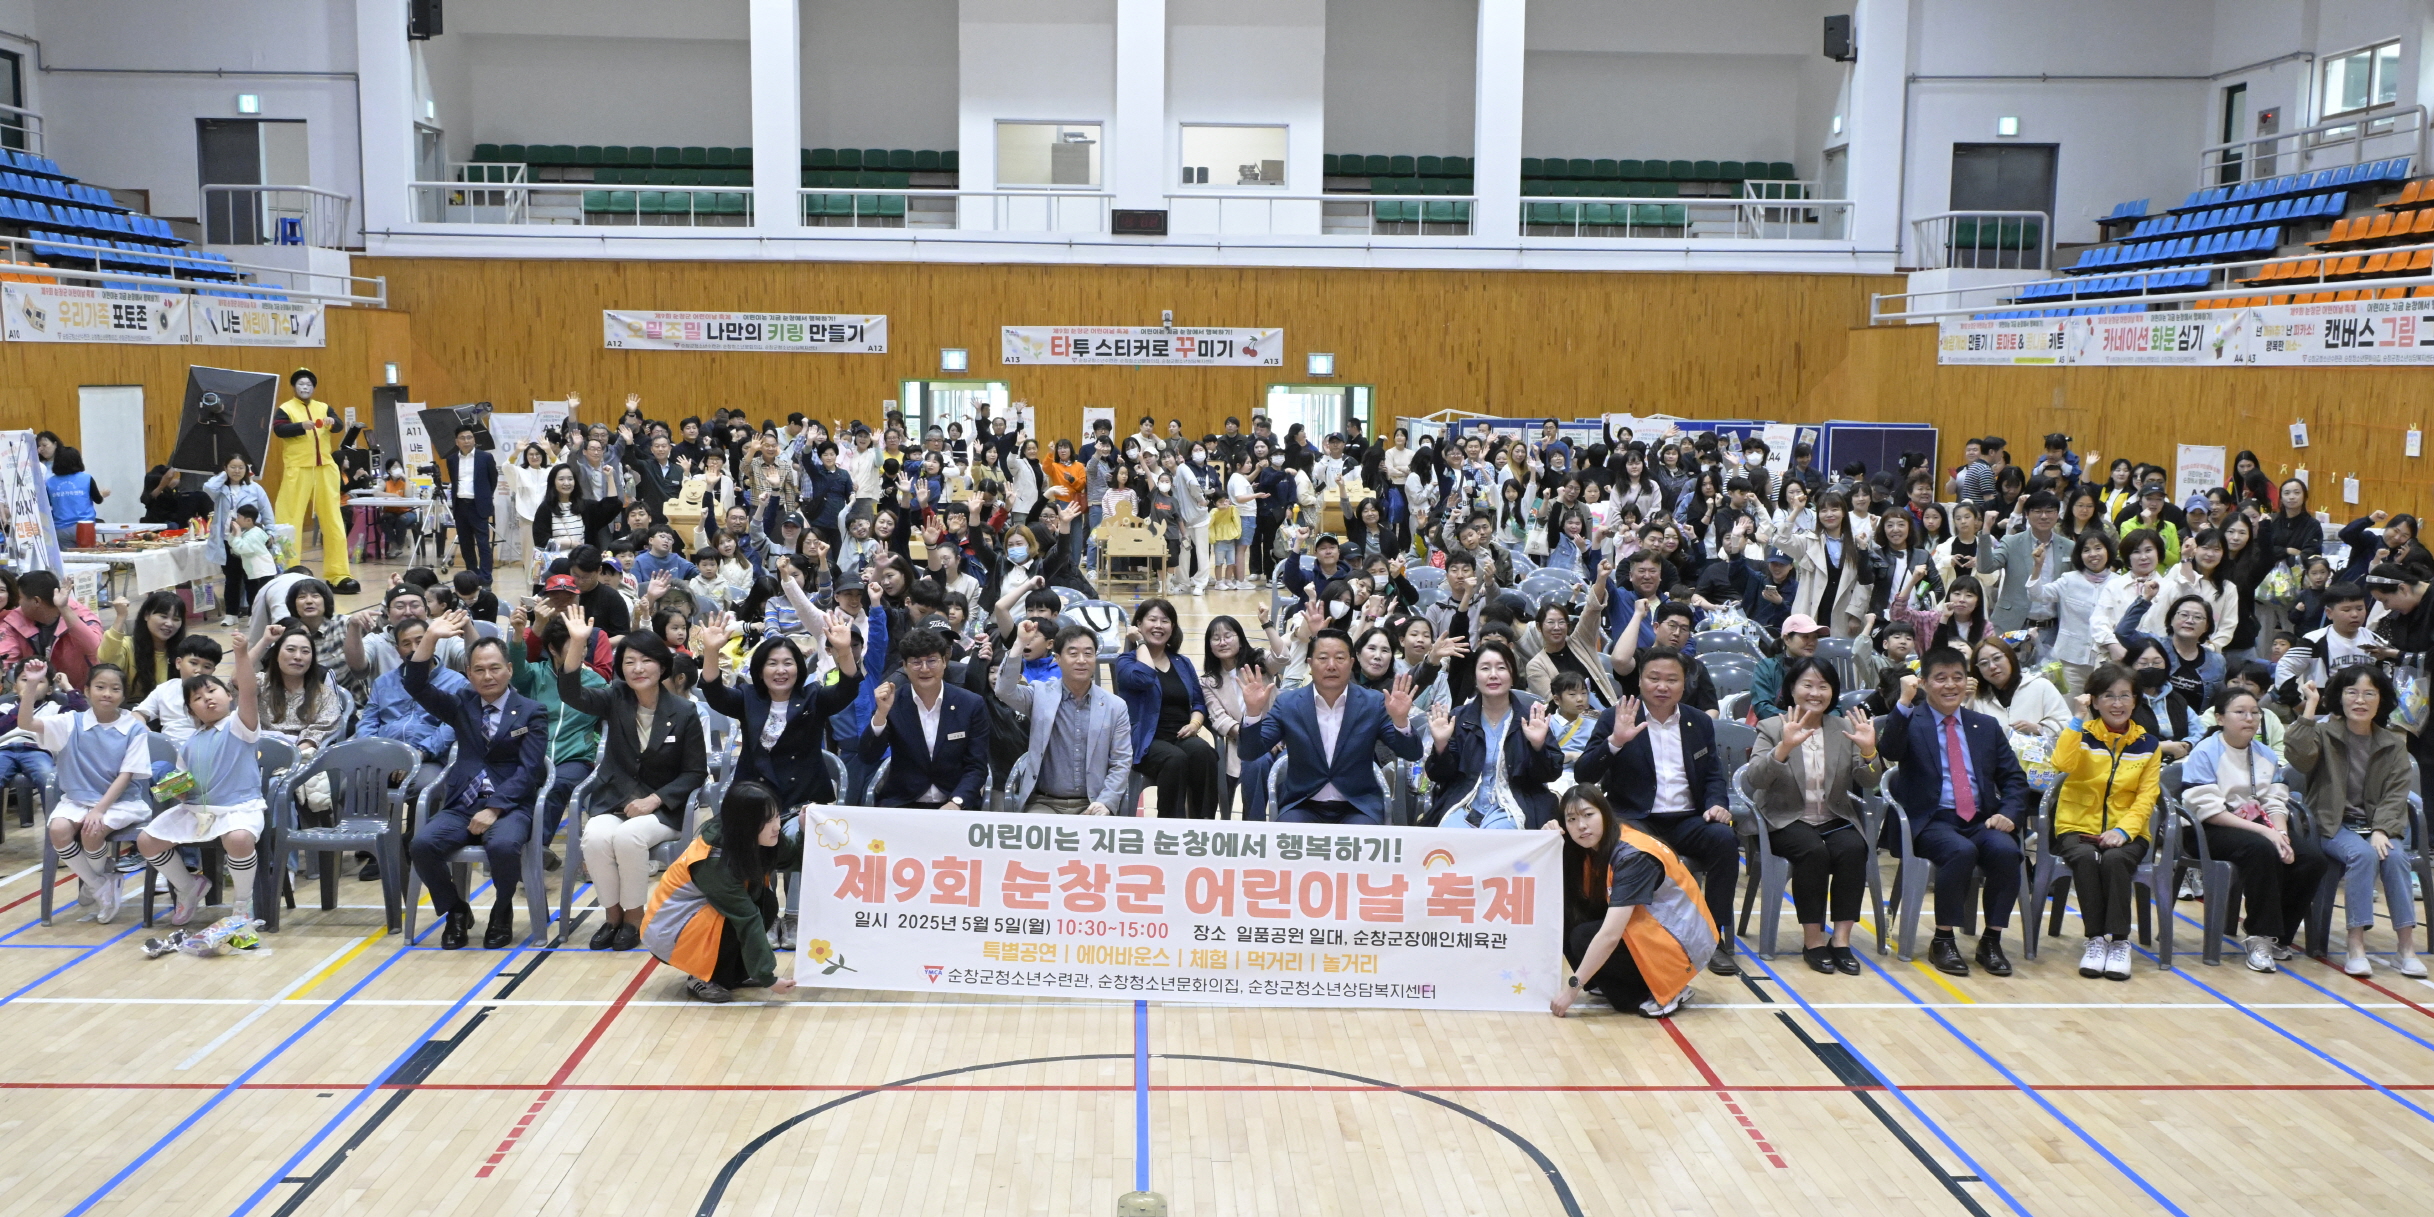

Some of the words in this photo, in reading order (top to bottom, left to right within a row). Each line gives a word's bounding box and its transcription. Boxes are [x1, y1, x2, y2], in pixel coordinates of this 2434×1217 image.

[59, 300, 110, 329] 우리가족
[112, 304, 148, 330] 포토존
[221, 310, 240, 333] 나는
[242, 311, 270, 335] 어린이
[271, 313, 299, 335] 가수다
[9, 330, 20, 339] A10
[180, 335, 189, 343] A10
[627, 321, 700, 340] 오밀조밀
[707, 322, 761, 341] 나만의
[768, 323, 803, 342] 키링
[809, 324, 864, 343] 만들기
[1968, 334, 1987, 350] 만들기
[1996, 334, 2017, 350] 토마토
[2018, 334, 2024, 350] &
[2049, 332, 2065, 350] 키트
[2103, 326, 2149, 351] 카네이션
[2151, 325, 2176, 351] 화분
[2178, 325, 2204, 351] 심기
[2256, 326, 2262, 337] 넌
[2286, 325, 2292, 336] 난
[2293, 324, 2315, 335] 피카소!
[2325, 318, 2374, 348] 캔버스
[2379, 316, 2416, 347] 그림
[1051, 335, 1090, 357] 타투
[1095, 339, 1169, 357] 스티커로
[1175, 337, 1233, 358] 꾸미기
[2266, 341, 2284, 351] 행복한
[2234, 354, 2243, 363] A4
[2248, 354, 2256, 363] A3
[406, 427, 422, 436] A11
[408, 454, 428, 463] 어린이
[409, 443, 424, 453] 나는
[968, 823, 1080, 852] 어린이는
[1089, 828, 1144, 855] 지금
[1154, 829, 1267, 859] 순창에서
[1276, 834, 1402, 863] 행복하기!
[833, 853, 982, 907] 제9회
[1001, 859, 1166, 914] 순창군
[1184, 866, 1409, 923] 어린이날
[1426, 872, 1535, 925] 축제
[855, 911, 888, 929] 일시
[897, 913, 957, 932] 2025년
[962, 916, 989, 933] 5월
[994, 917, 1051, 936] 5일(월)
[1056, 918, 1169, 939] 10:30~15:00
[1194, 925, 1226, 942] 장소
[1236, 926, 1304, 945] 일품공원
[1310, 927, 1348, 946] 일대,
[1353, 930, 1507, 950] 순창군장애인체육관
[982, 941, 1057, 963] 특별공연
[1076, 944, 1170, 967] 에어바운스
[1190, 949, 1228, 970] 체험
[1247, 951, 1302, 972] 먹거리
[1323, 952, 1378, 974] 놀거리
[948, 968, 1093, 989] 순창군청소년수련관,
[1098, 973, 1244, 995] 순창청소년문화의집,
[1248, 979, 1437, 1000] 순창군청소년상담복지센터
